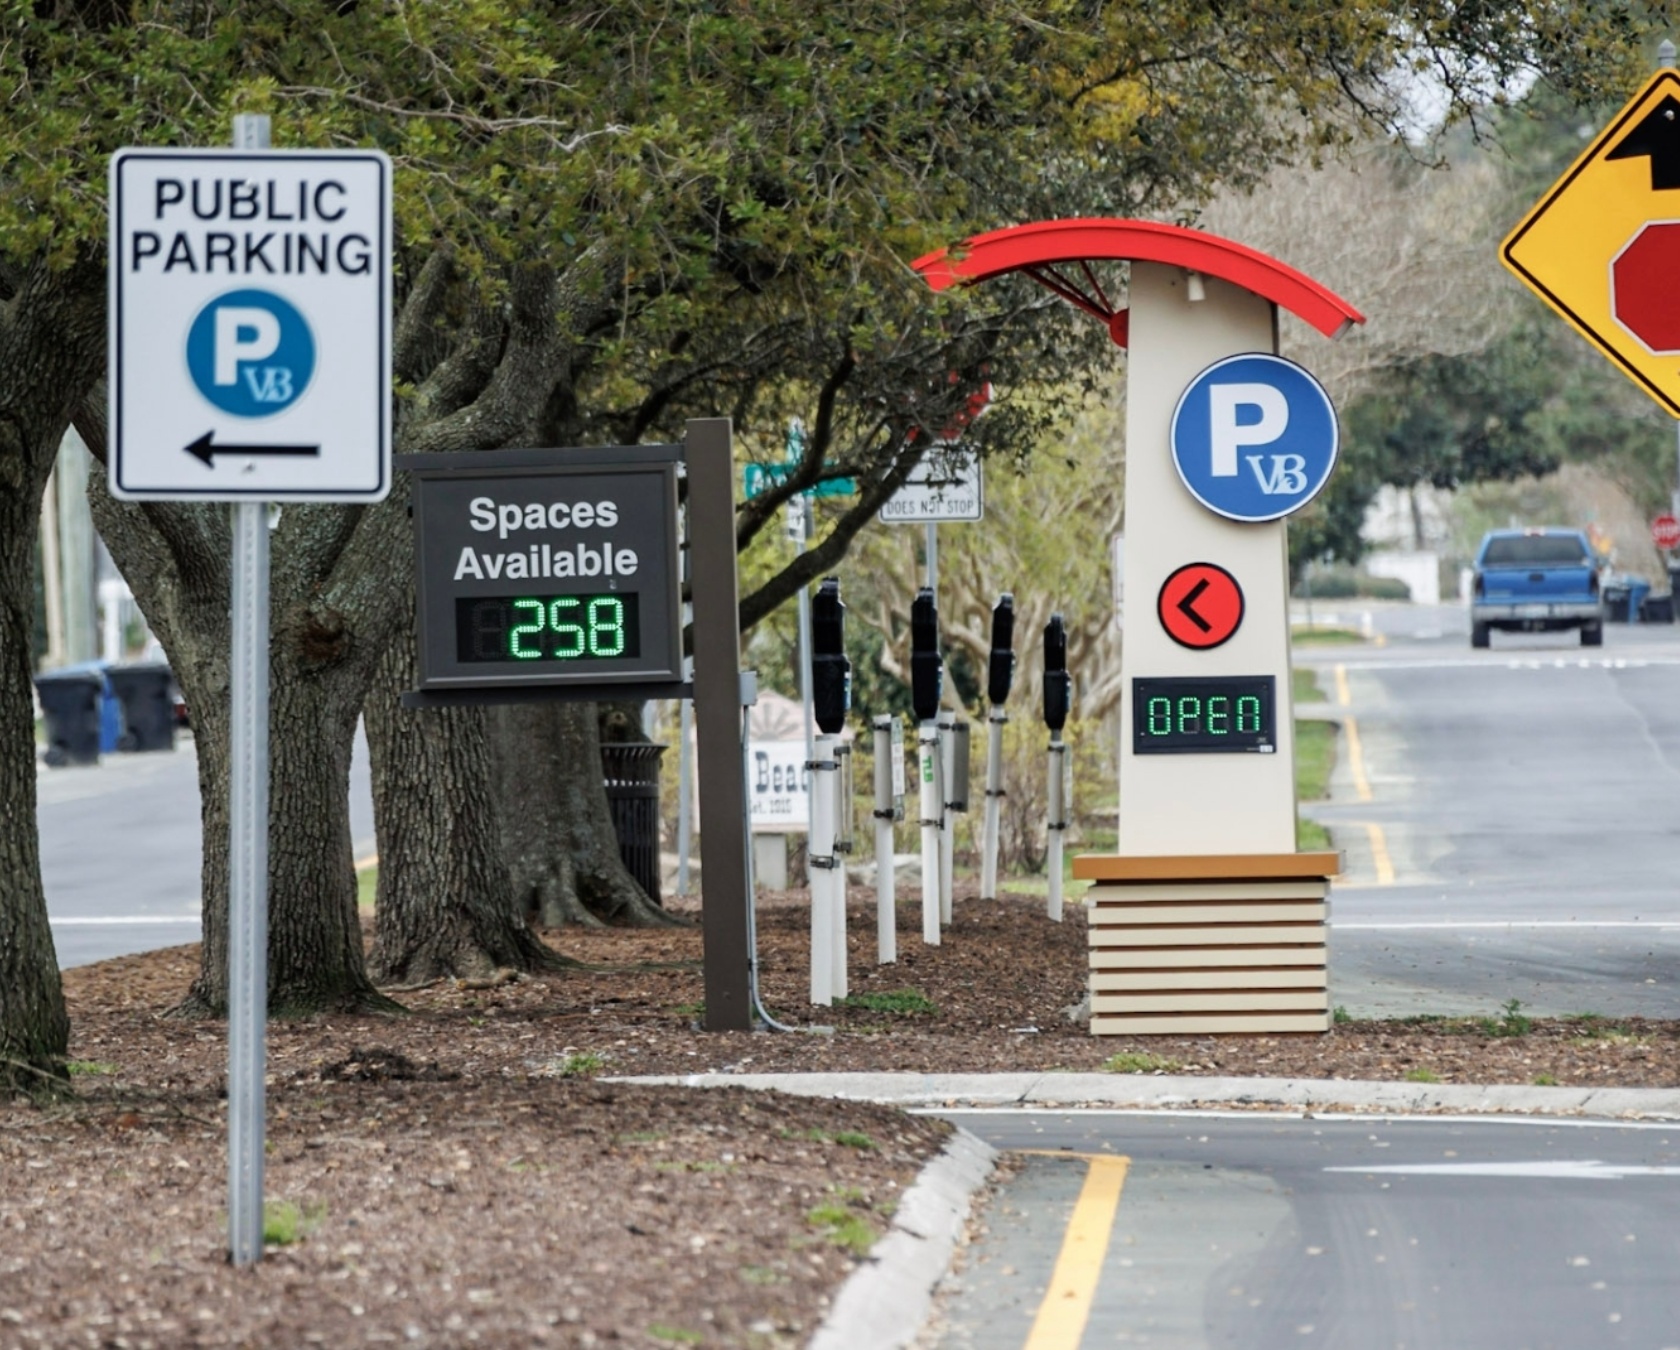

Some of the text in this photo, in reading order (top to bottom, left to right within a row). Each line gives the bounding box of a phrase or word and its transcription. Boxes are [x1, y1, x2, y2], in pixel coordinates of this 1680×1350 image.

[155, 178, 347, 221] PUBLIC
[132, 231, 372, 275] PARKING
[213, 306, 282, 386] P
[242, 366, 294, 401] VB
[1208, 382, 1290, 478] P
[1245, 453, 1309, 495] VB
[469, 497, 619, 539] Spaces
[887, 499, 974, 515] DOES NOT STOP
[453, 542, 639, 580] Available
[510, 598, 625, 658] 258
[1148, 696, 1261, 735] OPEN
